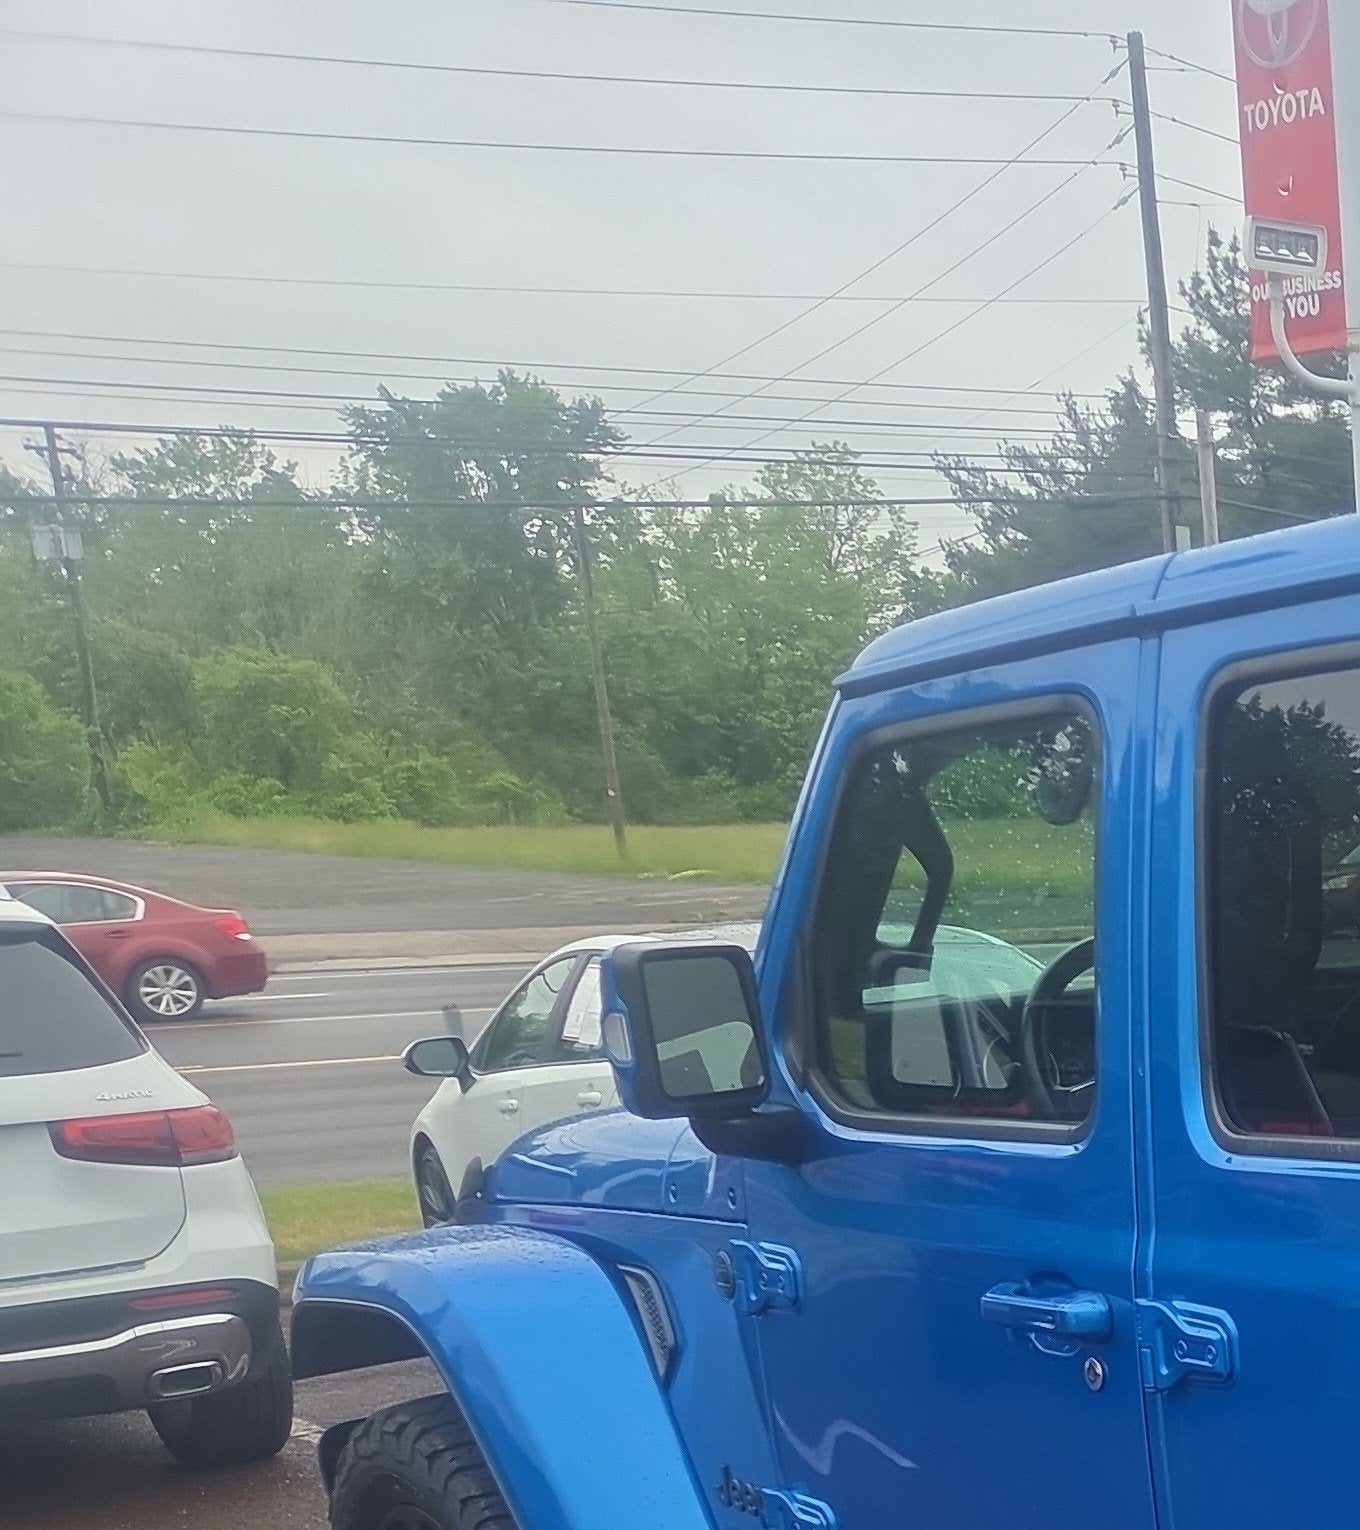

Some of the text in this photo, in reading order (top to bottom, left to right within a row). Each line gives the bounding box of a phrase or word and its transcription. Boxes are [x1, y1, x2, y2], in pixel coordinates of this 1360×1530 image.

[1244, 87, 1325, 132] TOYOTA
[1252, 282, 1272, 302] OU
[1286, 293, 1320, 319] YOU
